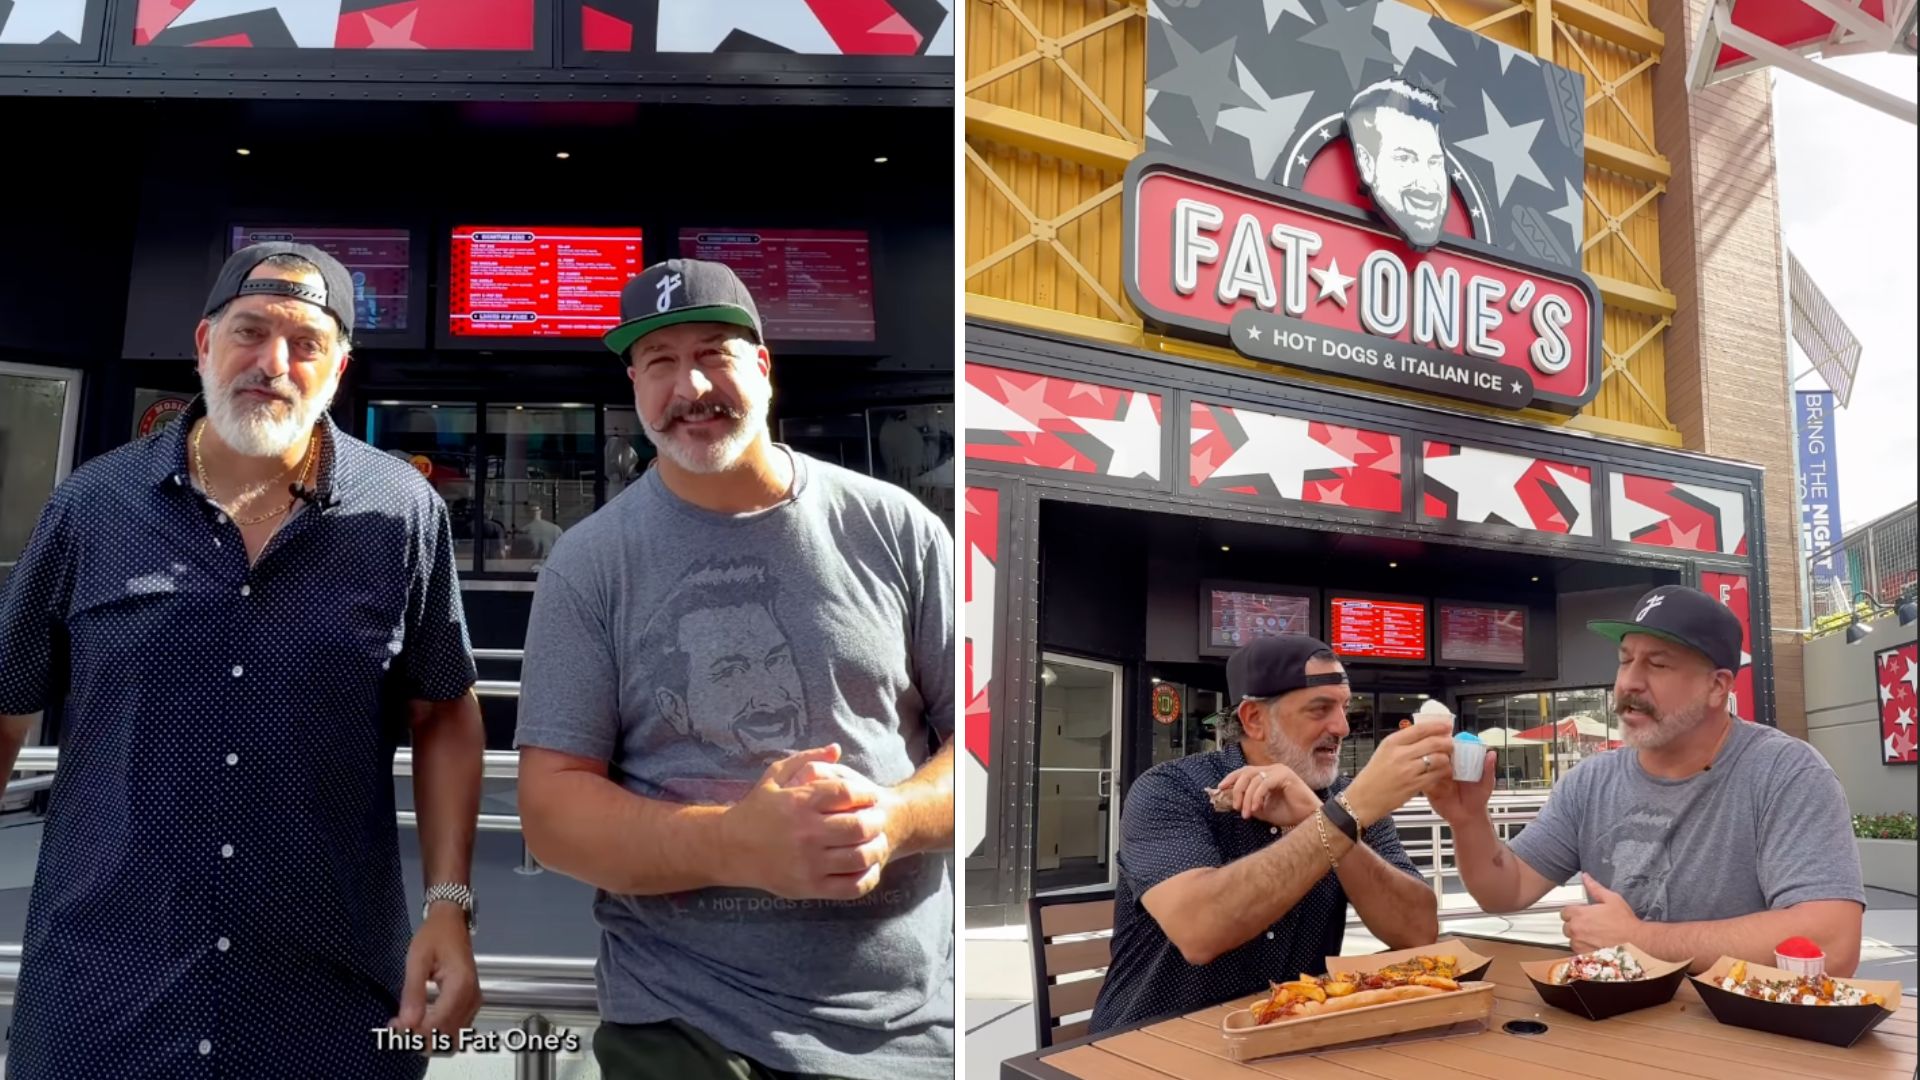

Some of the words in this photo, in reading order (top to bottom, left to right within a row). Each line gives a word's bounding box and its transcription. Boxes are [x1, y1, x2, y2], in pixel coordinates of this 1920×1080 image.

[1175, 198, 1323, 318] FAT
[1361, 250, 1573, 374] ONE'S
[1273, 329, 1317, 353] HOT
[1322, 339, 1378, 366] DOGS
[1383, 353, 1396, 370] &
[1401, 356, 1469, 385] ITALIAN
[1474, 371, 1502, 391] ICE
[1805, 394, 1825, 454] BRING
[1810, 463, 1828, 498] THE
[1812, 504, 1832, 570] NIGHT
[713, 898, 741, 911] HOT
[748, 897, 797, 911] DOGS
